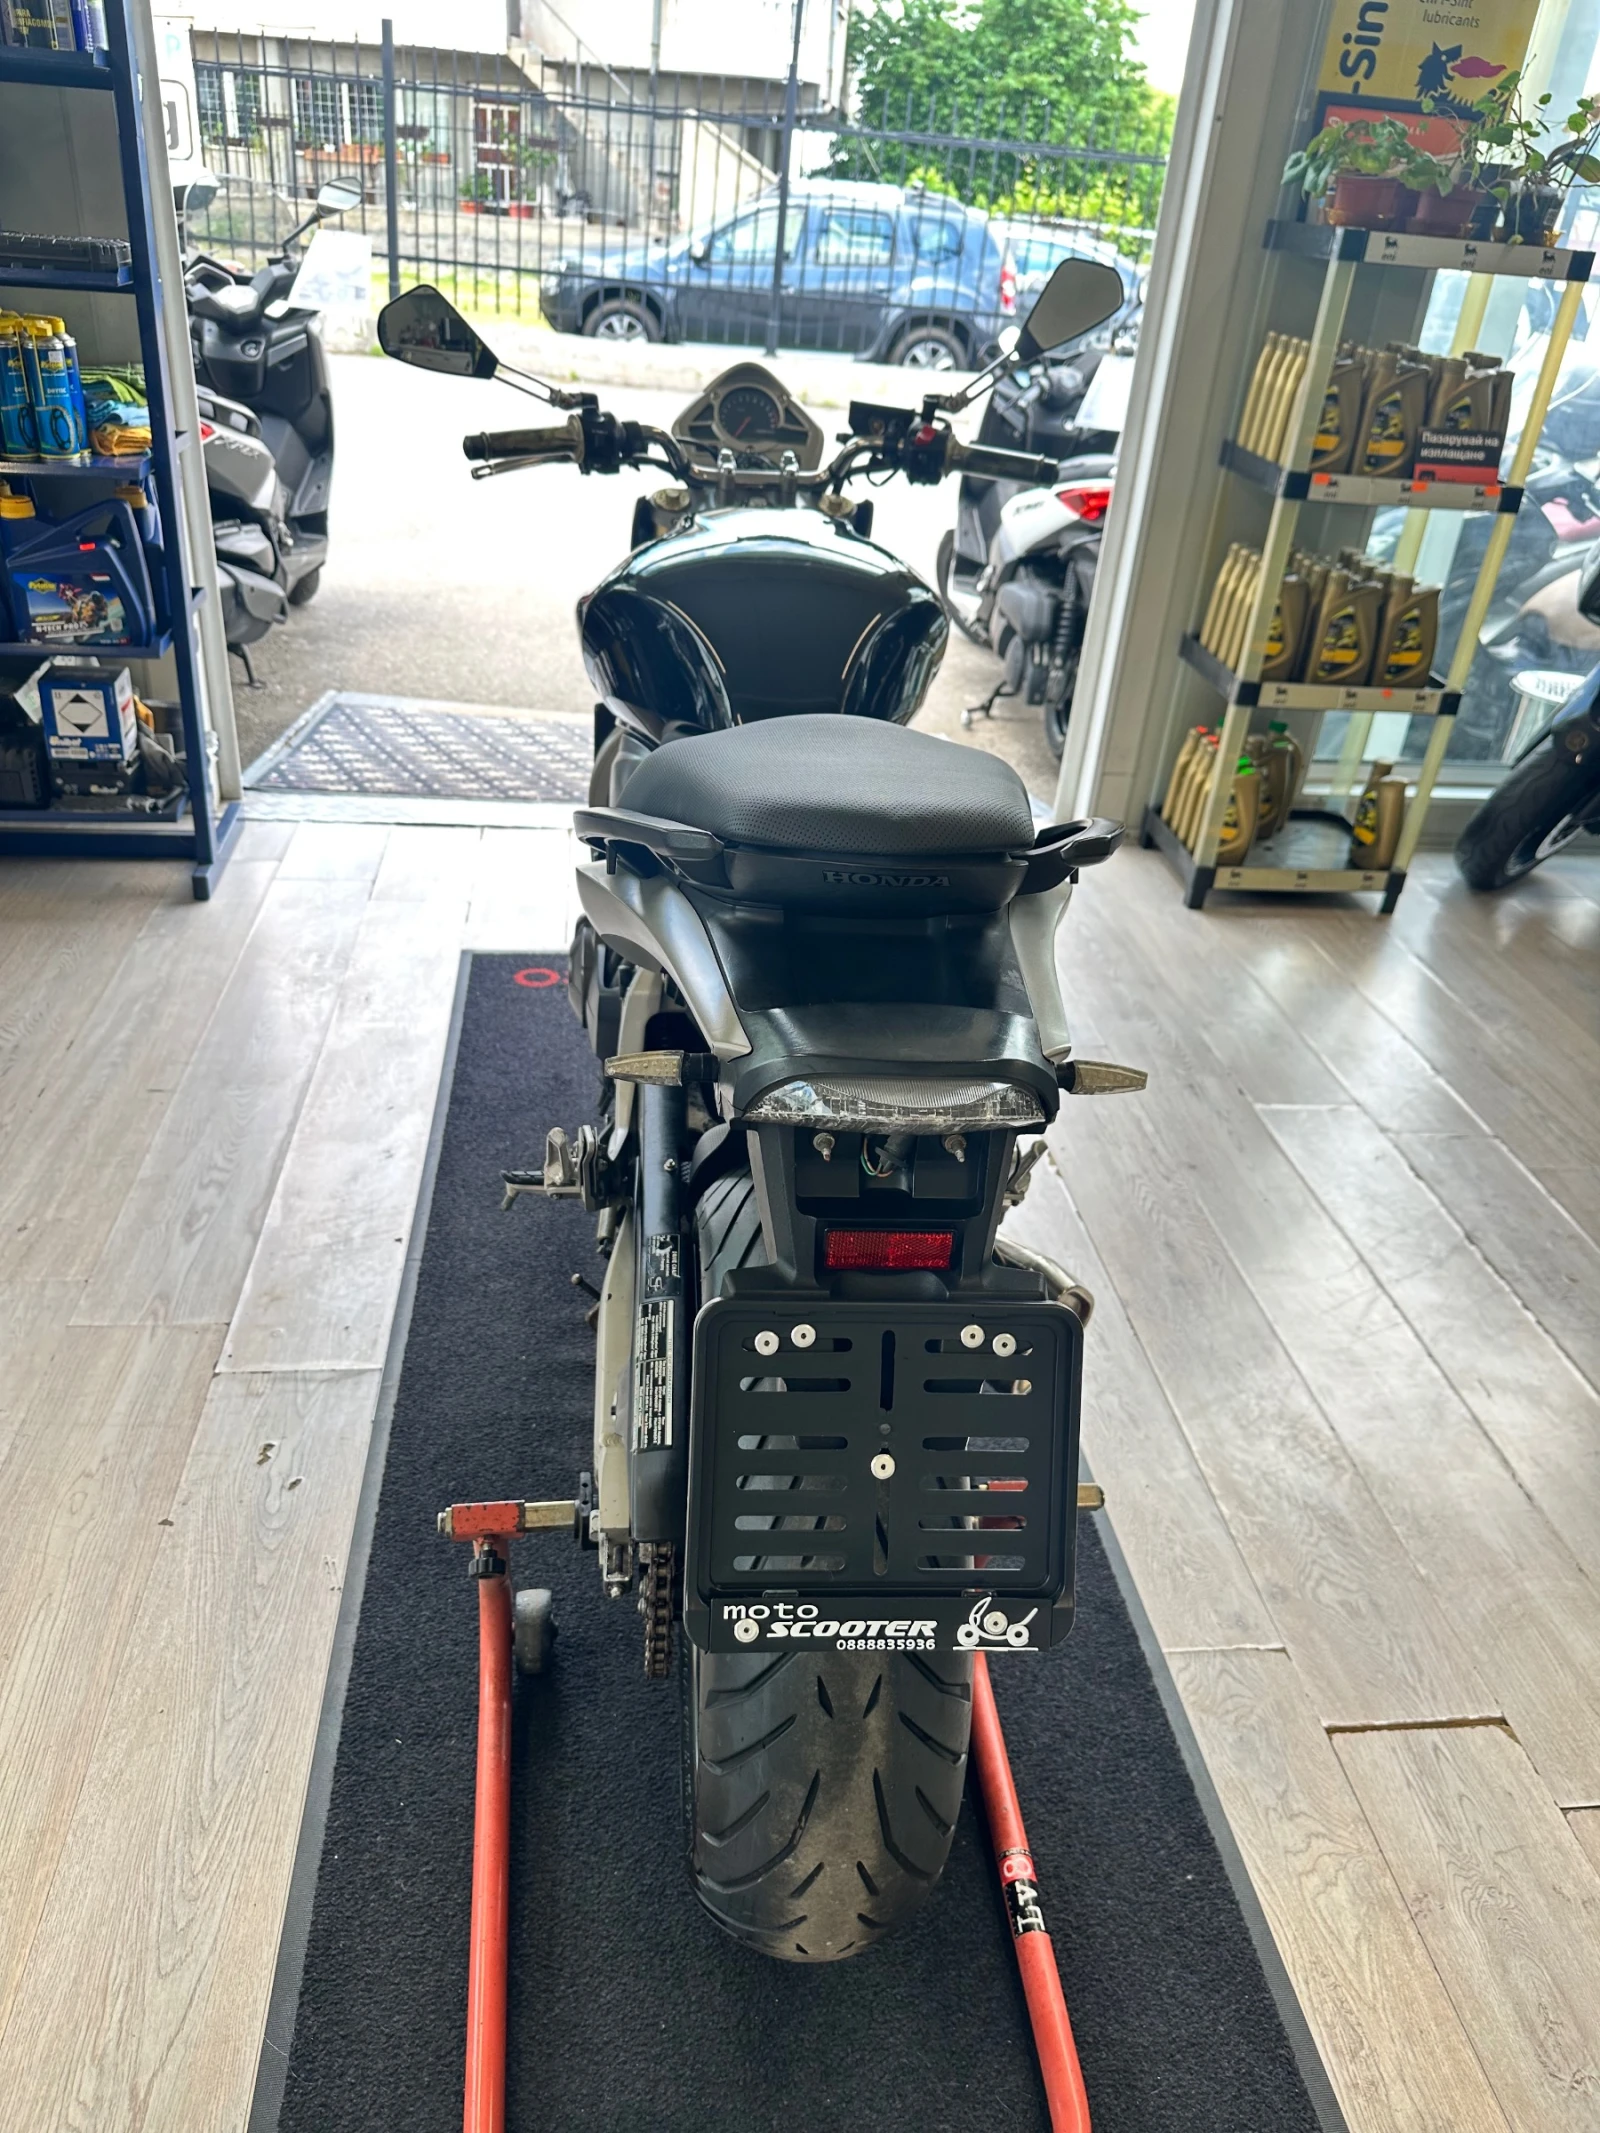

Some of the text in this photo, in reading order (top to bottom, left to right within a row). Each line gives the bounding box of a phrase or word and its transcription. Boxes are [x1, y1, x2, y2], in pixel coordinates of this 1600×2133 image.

[1422, 9, 1480, 29] lubricants
[1422, 431, 1500, 448] Пазарувай на
[823, 870, 951, 887] HONDA
[723, 1602, 819, 1620] moto
[766, 1620, 938, 1638] SCOOTER
[836, 1639, 936, 1651] 0888835936
